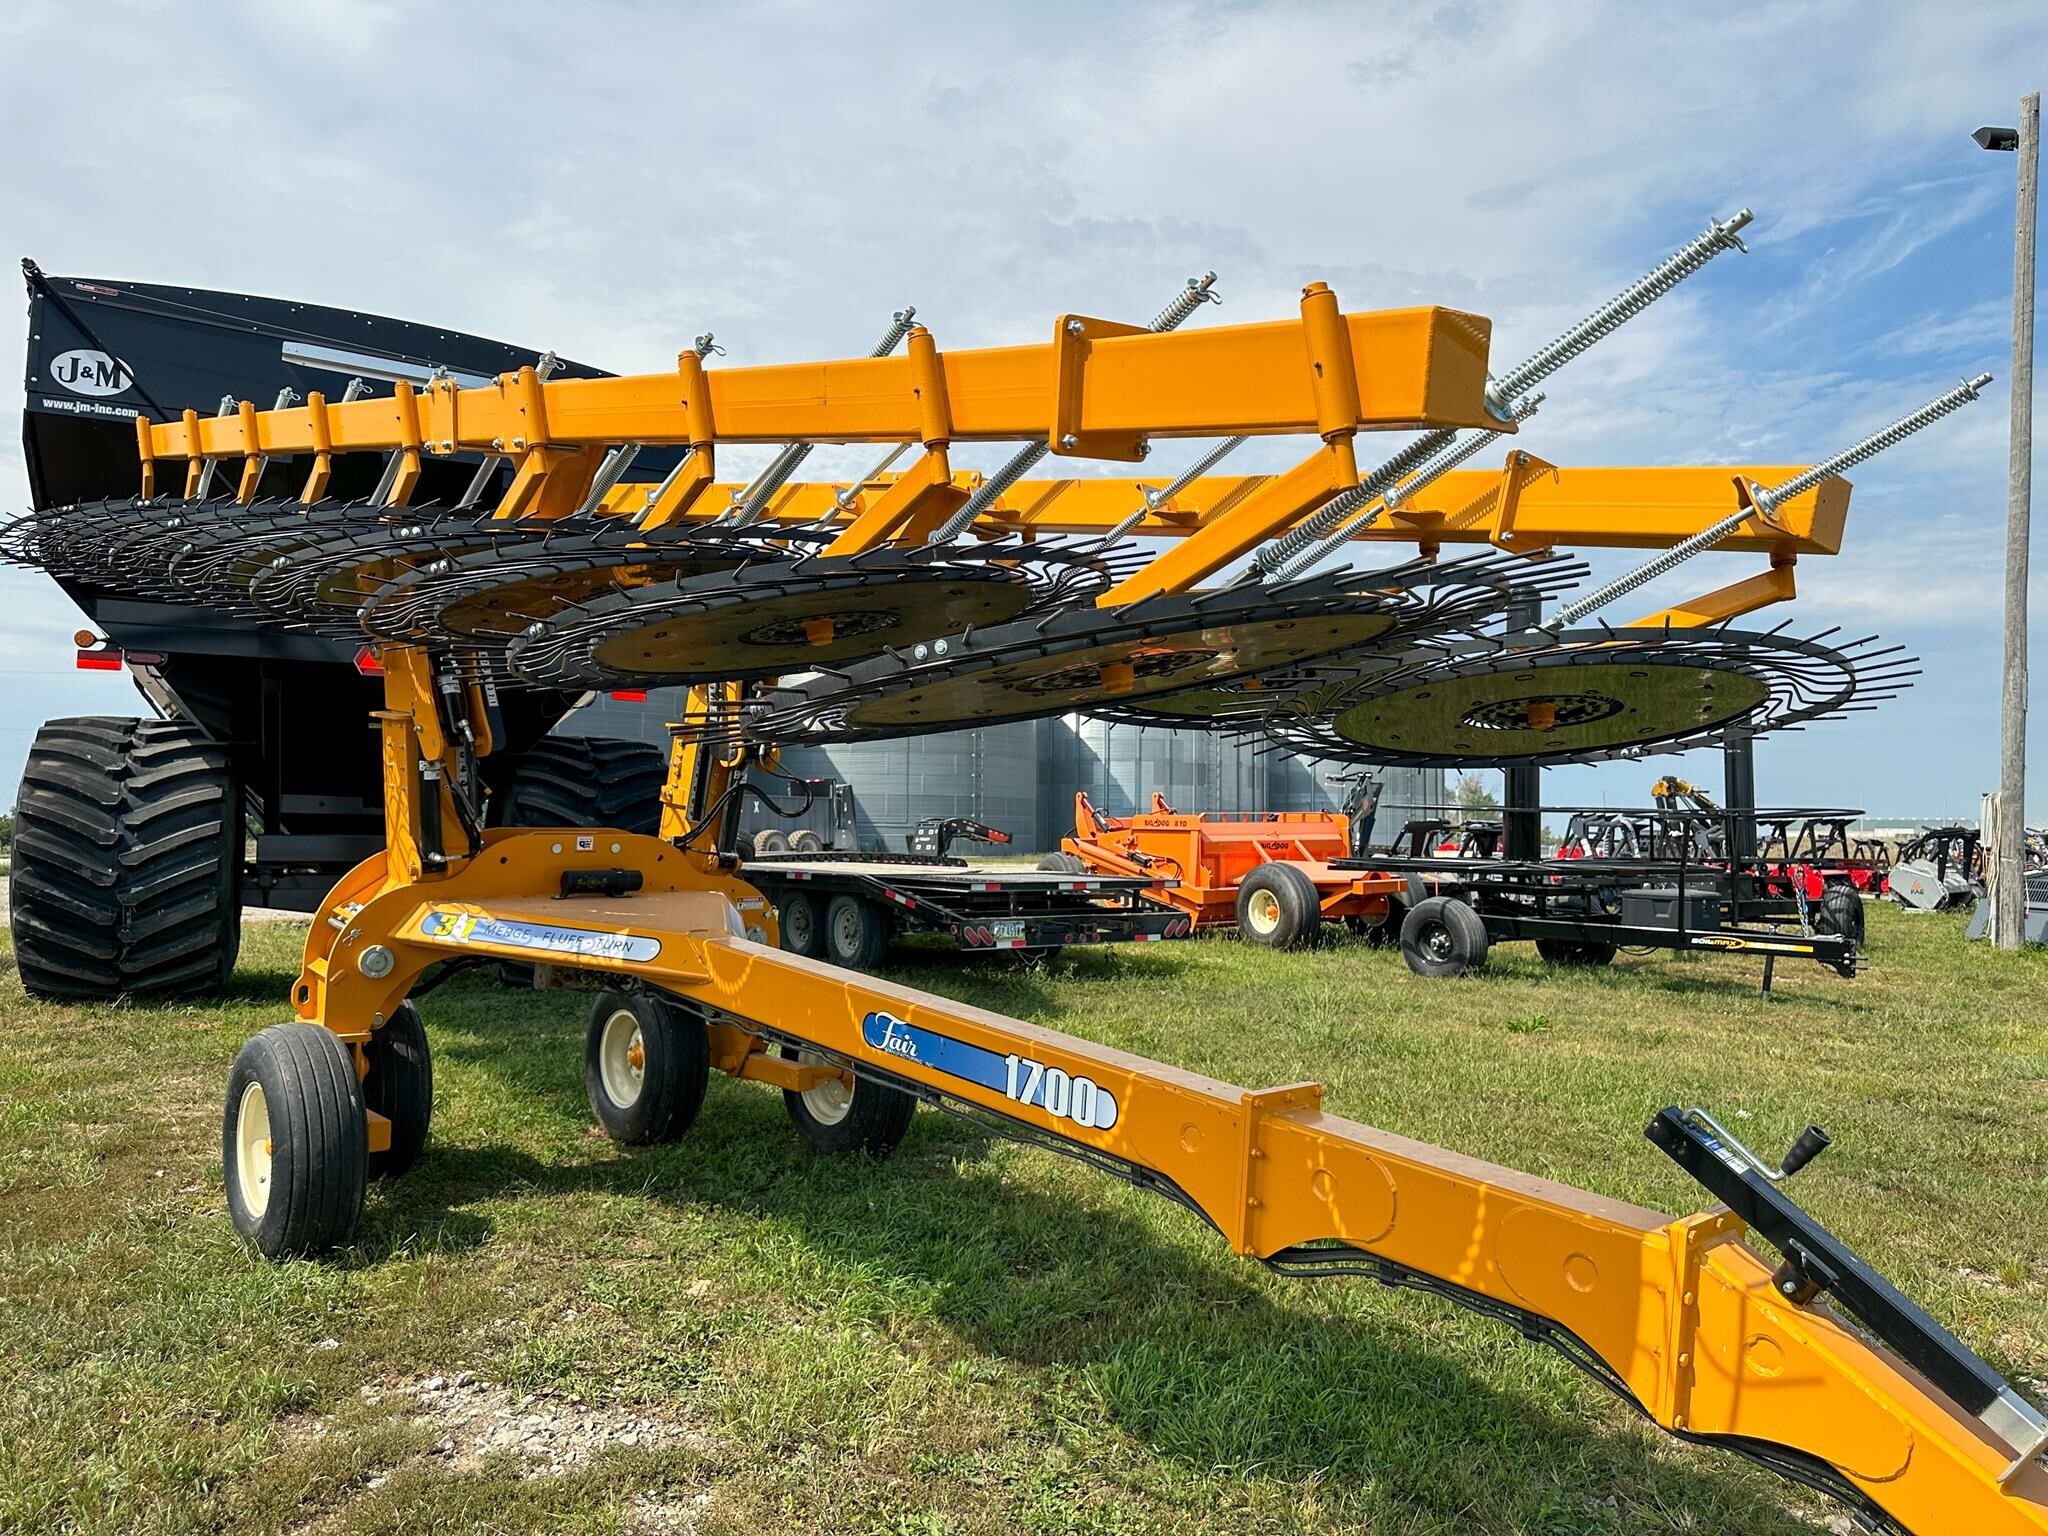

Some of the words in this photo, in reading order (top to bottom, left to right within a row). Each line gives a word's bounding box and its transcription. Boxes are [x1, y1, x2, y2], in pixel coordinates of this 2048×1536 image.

[57, 356, 121, 390] J&M
[42, 398, 139, 418] www.jm-inc.com
[434, 914, 459, 936] 3
[483, 924, 532, 940] MERGE
[541, 931, 585, 946] FLUFF
[596, 937, 634, 953] TURN
[871, 1011, 918, 1057] Fair
[1004, 1053, 1098, 1128] 1700
